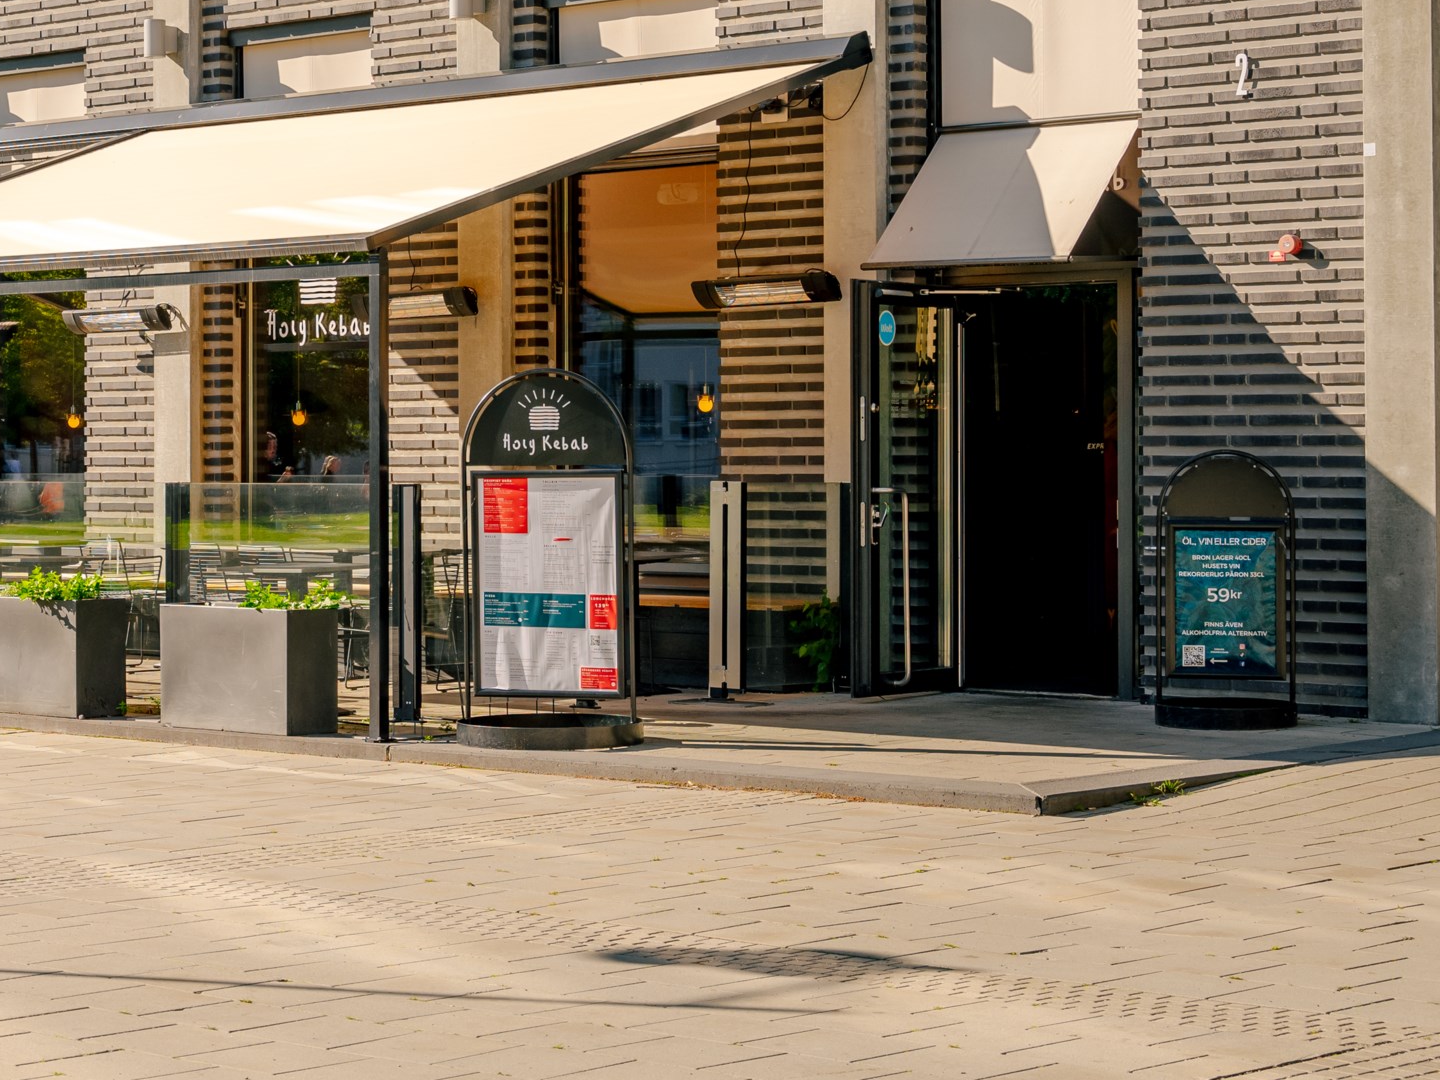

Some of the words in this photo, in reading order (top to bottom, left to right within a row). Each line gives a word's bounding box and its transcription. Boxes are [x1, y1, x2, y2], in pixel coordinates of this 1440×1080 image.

[1235, 53, 1249, 96] 2
[266, 309, 306, 347] Holy
[503, 432, 536, 456] Holy
[542, 434, 589, 452] Kebab
[1181, 535, 1197, 546] ÖL,
[1198, 537, 1213, 545] VIN
[1214, 537, 1240, 546] ELLER
[1241, 537, 1267, 546] CIDER
